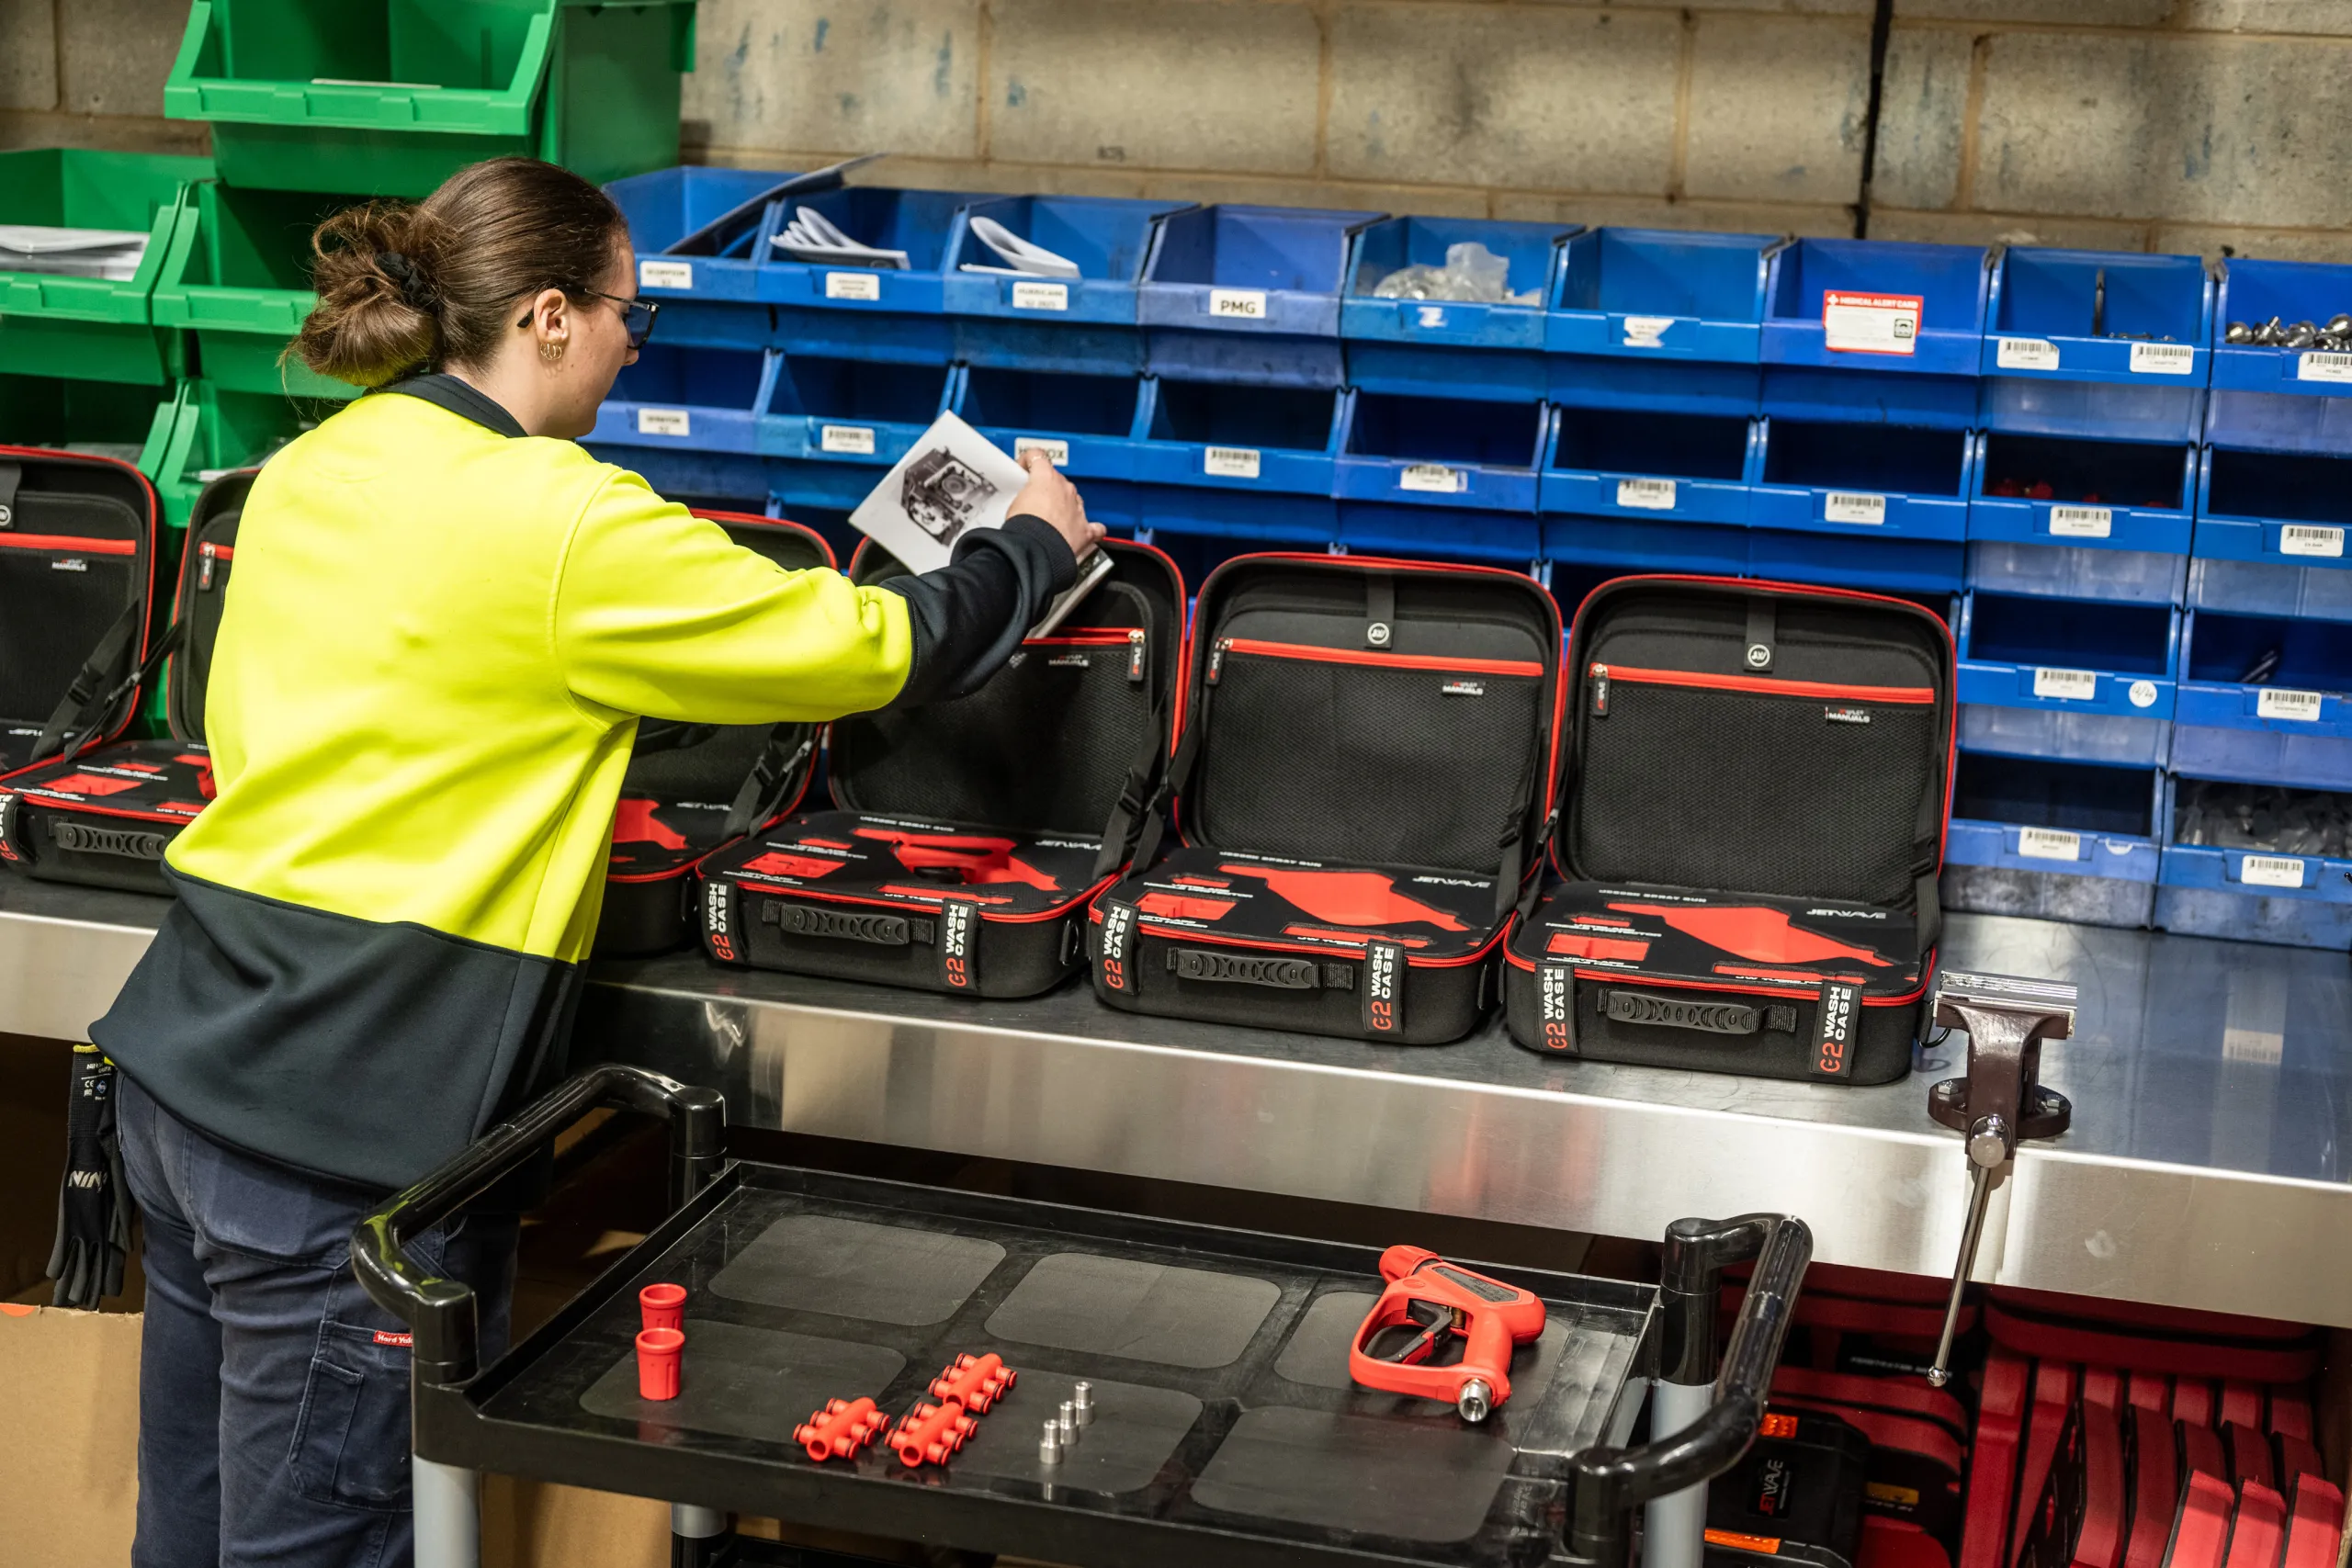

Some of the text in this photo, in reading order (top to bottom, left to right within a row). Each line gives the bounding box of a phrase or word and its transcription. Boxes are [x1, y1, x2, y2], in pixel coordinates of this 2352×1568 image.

[1220, 300, 1256, 314] PMG
[1839, 297, 1918, 309] MEDICAL ALERT CARD
[1442, 685, 1482, 695] MANUALS
[1828, 713, 1870, 723] MANUALS
[1412, 875, 1491, 888] JETWAVE
[708, 883, 718, 931] WASH
[718, 885, 728, 933] CASE
[945, 904, 958, 954] WASH
[955, 906, 968, 956] CASE
[1103, 906, 1122, 955] WASH
[1806, 908, 1886, 919] JETWAVE
[1113, 908, 1131, 959] CASE
[1371, 946, 1385, 998] WASH
[1381, 947, 1395, 999] CASE
[1544, 968, 1554, 1020] WASH
[1554, 968, 1565, 1021] CASE
[1823, 986, 1840, 1039] WASH
[1835, 987, 1852, 1042] CASE
[378, 1334, 397, 1343] Hard
[1758, 1459, 1784, 1517] JETWAVE
